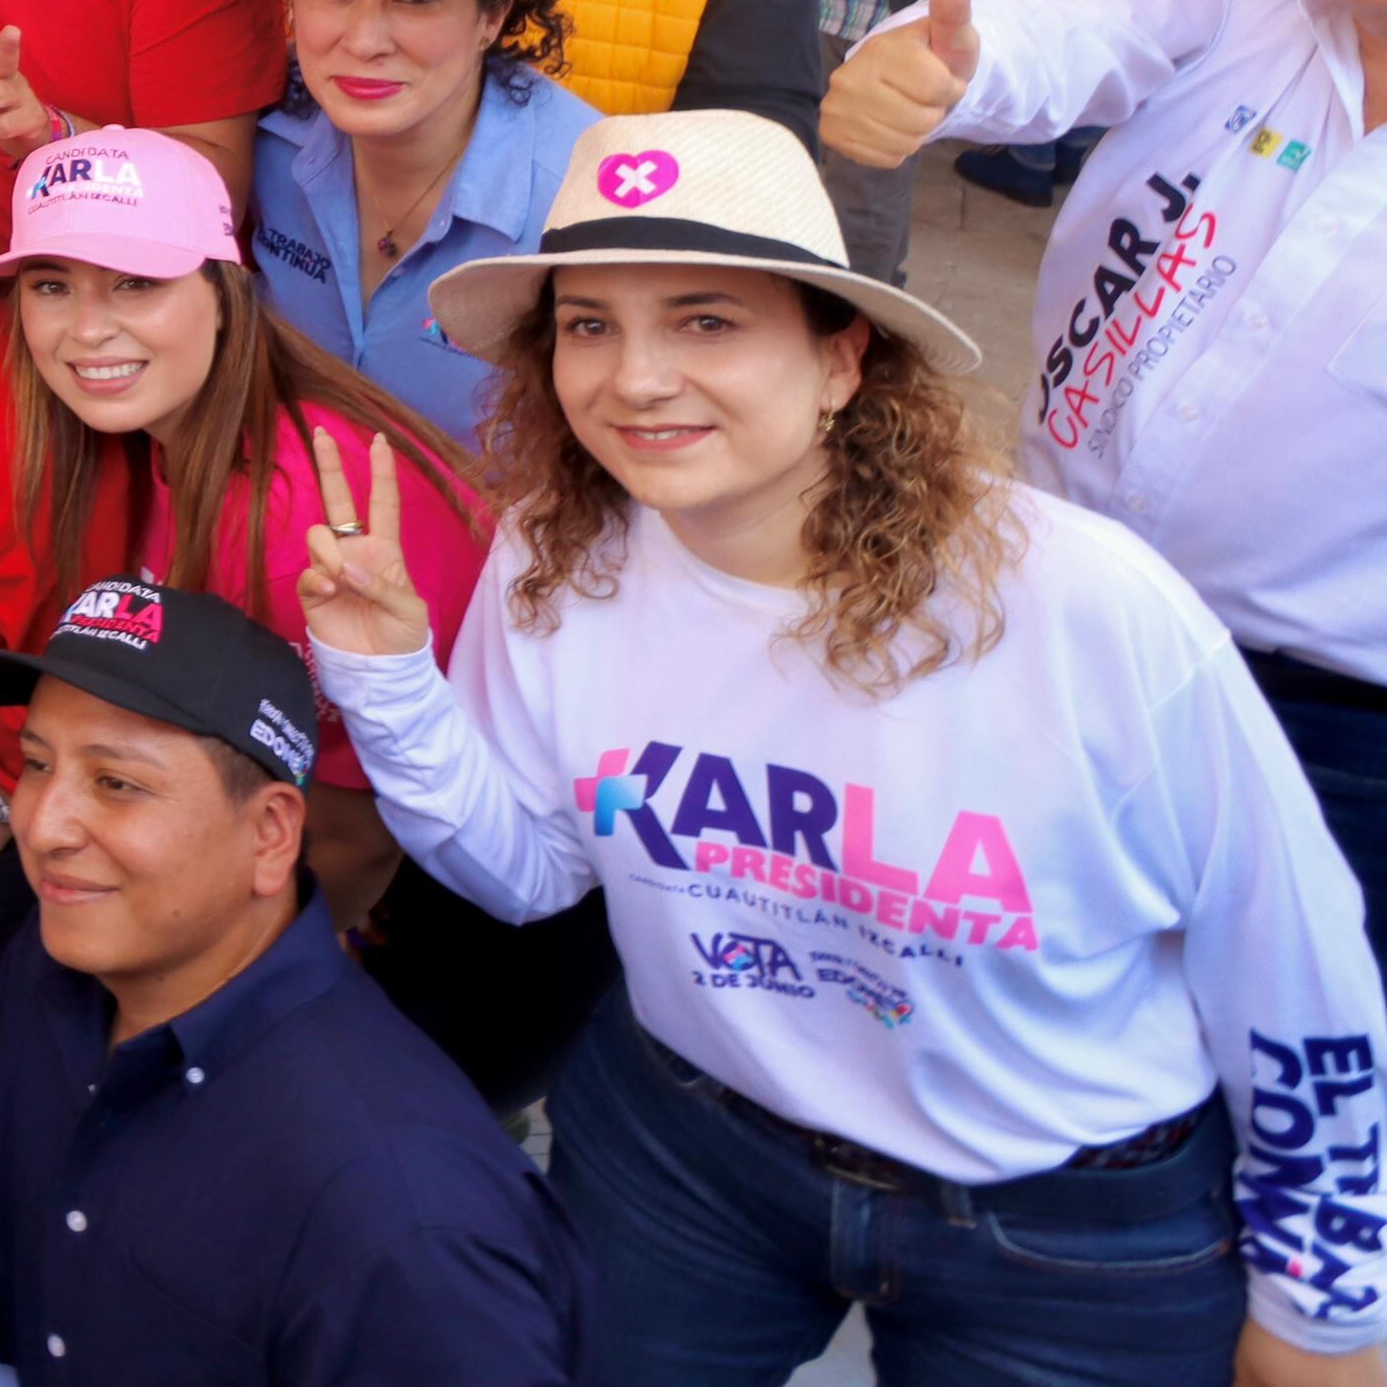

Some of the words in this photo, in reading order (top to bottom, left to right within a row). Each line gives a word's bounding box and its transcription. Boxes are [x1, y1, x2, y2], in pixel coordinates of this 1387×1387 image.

[27, 159, 141, 200] KARLA
[46, 147, 129, 165] CANDIDATA
[1146, 171, 1201, 223] J.
[268, 228, 331, 270] TRABAJO
[1048, 203, 1216, 449] CASILLAS
[1129, 254, 1237, 382] PROPIETARIO
[99, 629, 147, 650] IZCALLI
[574, 740, 1034, 914] KARLA
[694, 841, 1039, 952] PRESIDENTA
[689, 932, 802, 982] VOTA
[860, 925, 964, 968] IZCALLI
[710, 972, 741, 990] DE
[1303, 1033, 1374, 1116] EL
